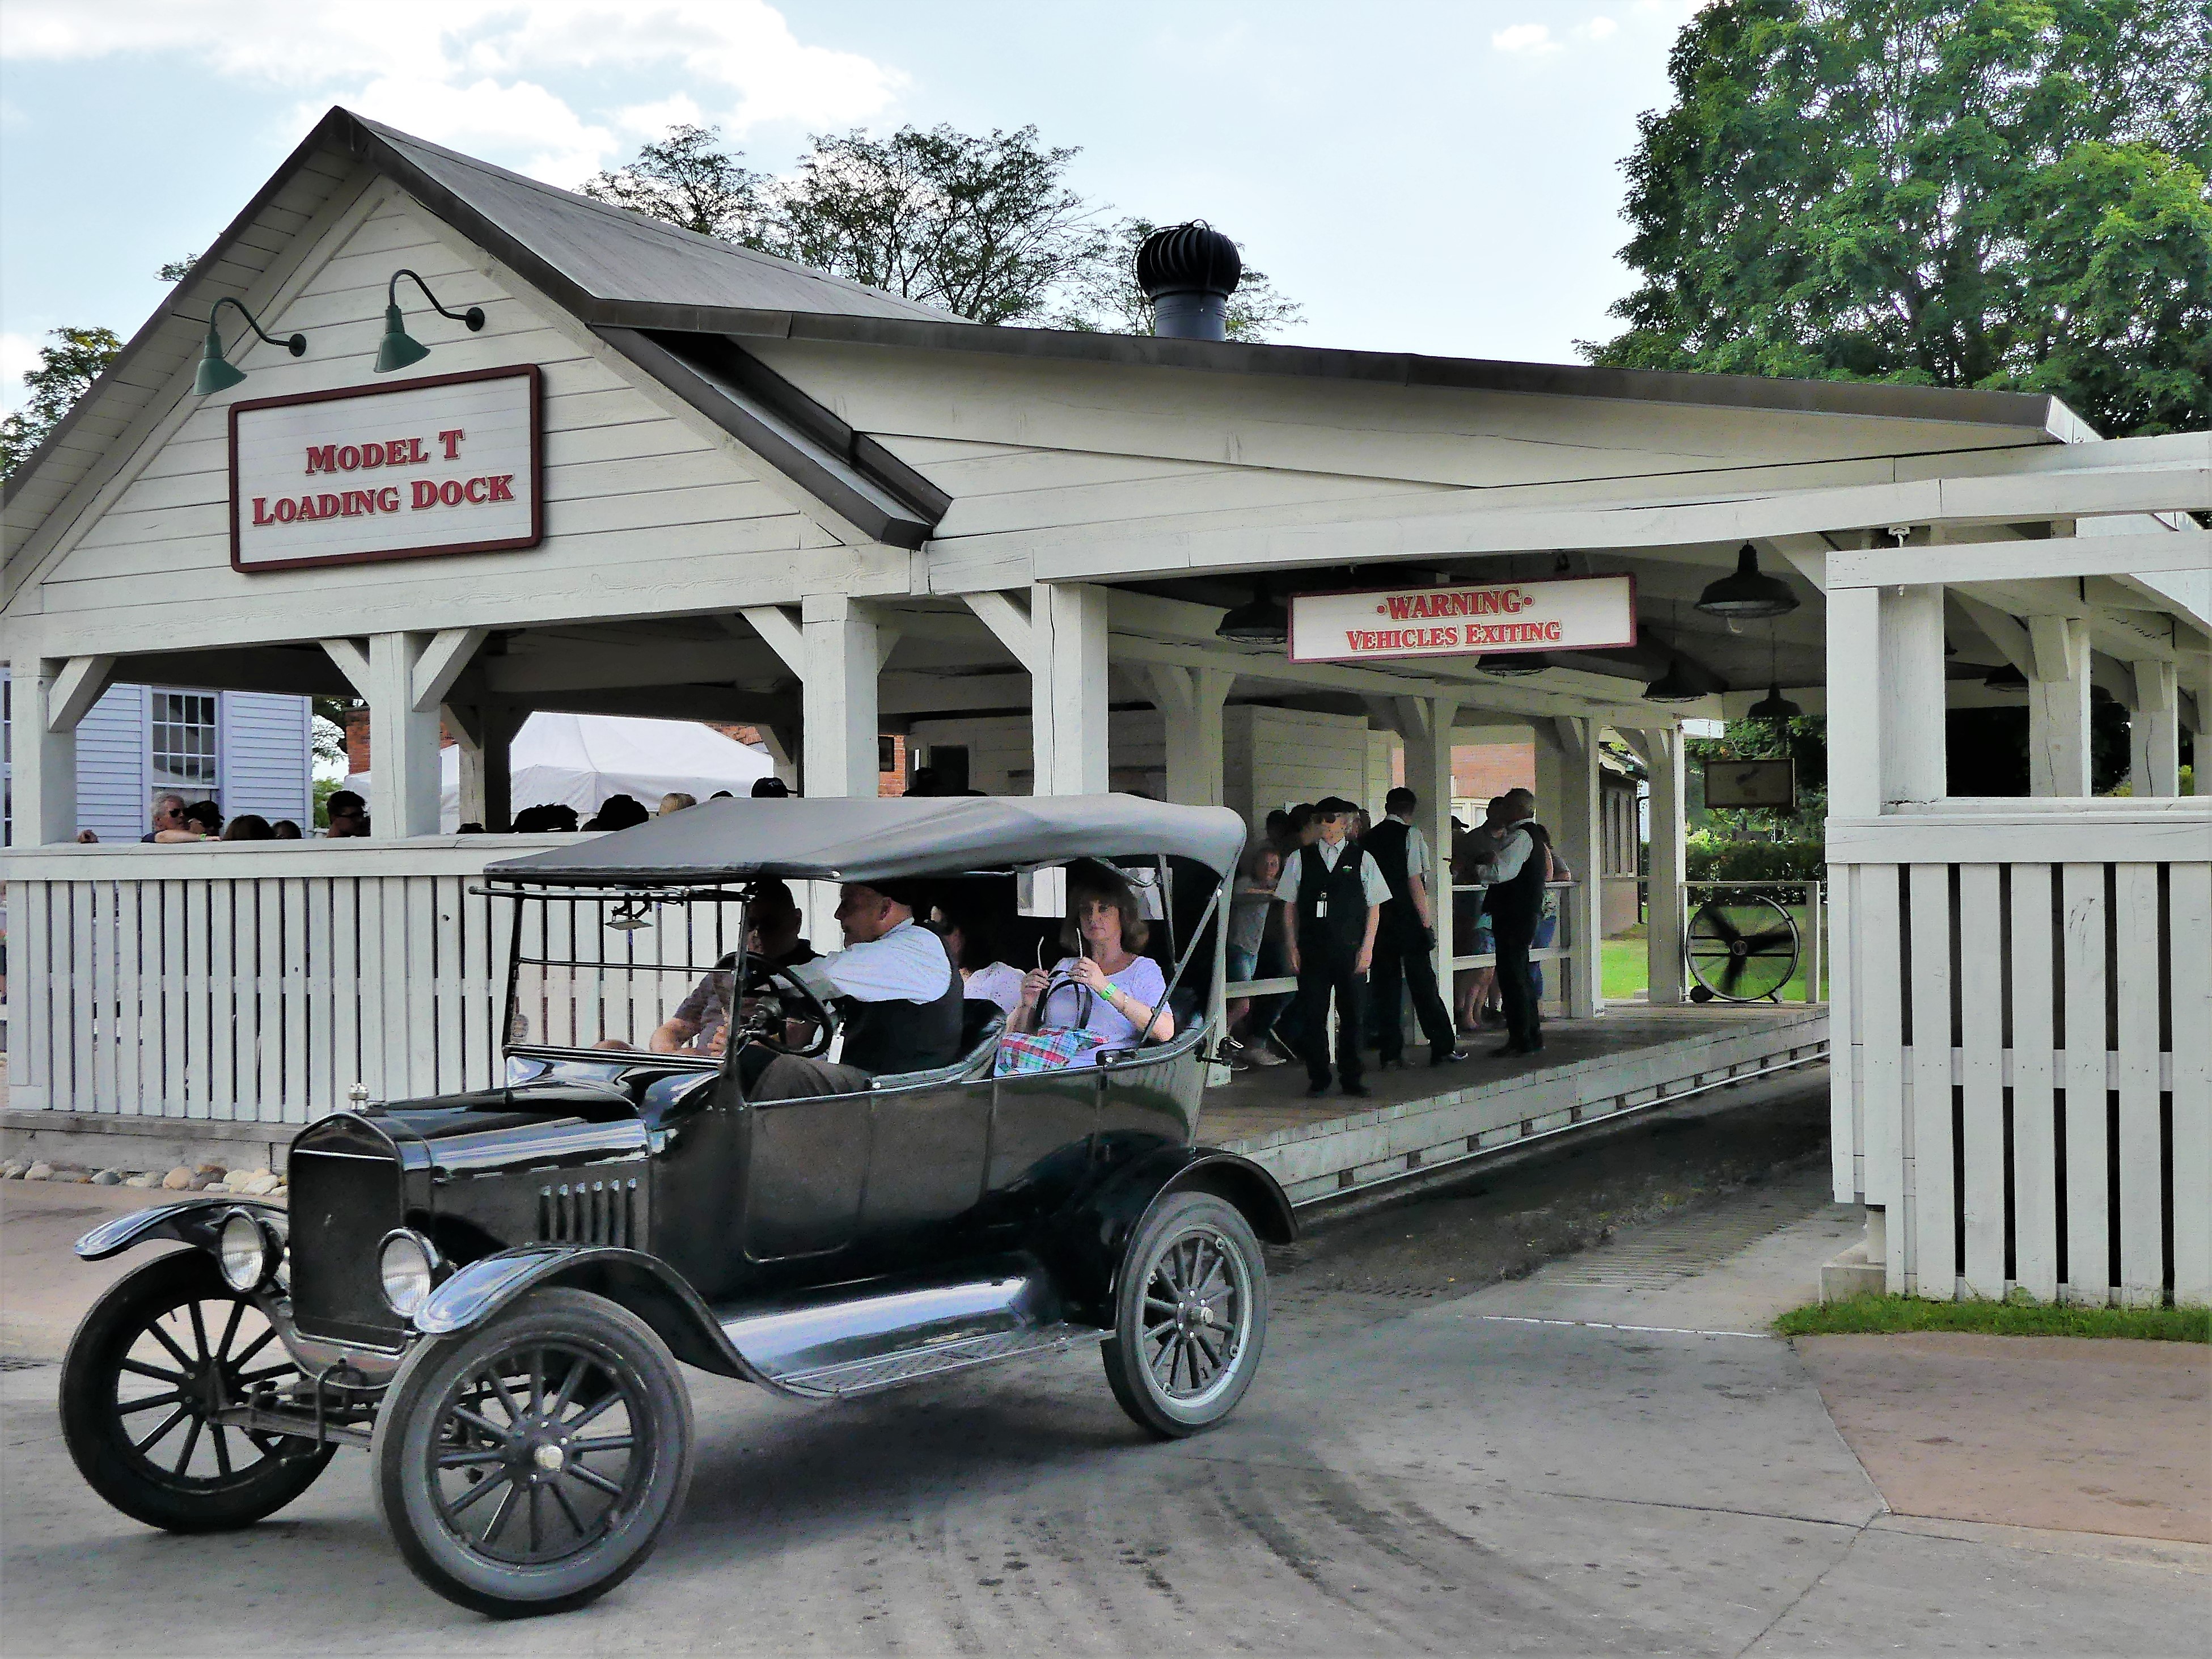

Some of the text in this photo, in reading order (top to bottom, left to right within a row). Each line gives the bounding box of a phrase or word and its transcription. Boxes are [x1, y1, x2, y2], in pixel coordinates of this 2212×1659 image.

[305, 428, 464, 474] MODEL T
[252, 474, 514, 525] LOADING DOCK
[1386, 589, 1522, 620] WARNING
[1346, 620, 1562, 651] VEHICLES EXITING
